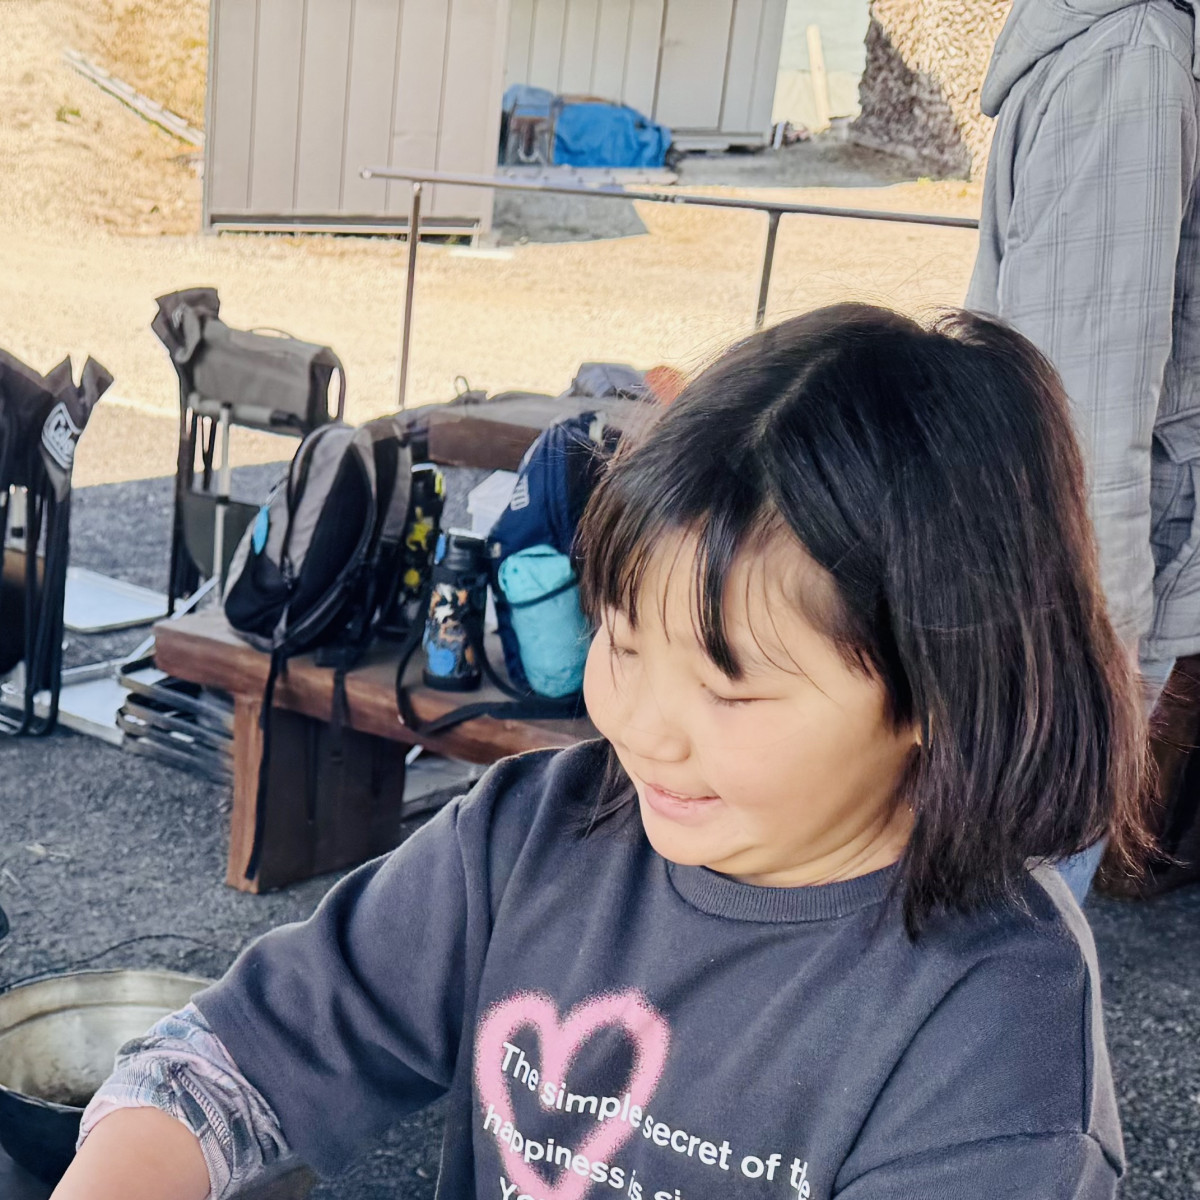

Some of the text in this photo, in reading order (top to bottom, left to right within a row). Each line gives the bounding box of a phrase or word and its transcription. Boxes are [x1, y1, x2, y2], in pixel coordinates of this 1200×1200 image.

[483, 1103, 625, 1189] happiness
[502, 1041, 539, 1091] The
[541, 1080, 643, 1128] simple
[643, 1115, 733, 1171] secret
[740, 1153, 782, 1181] of
